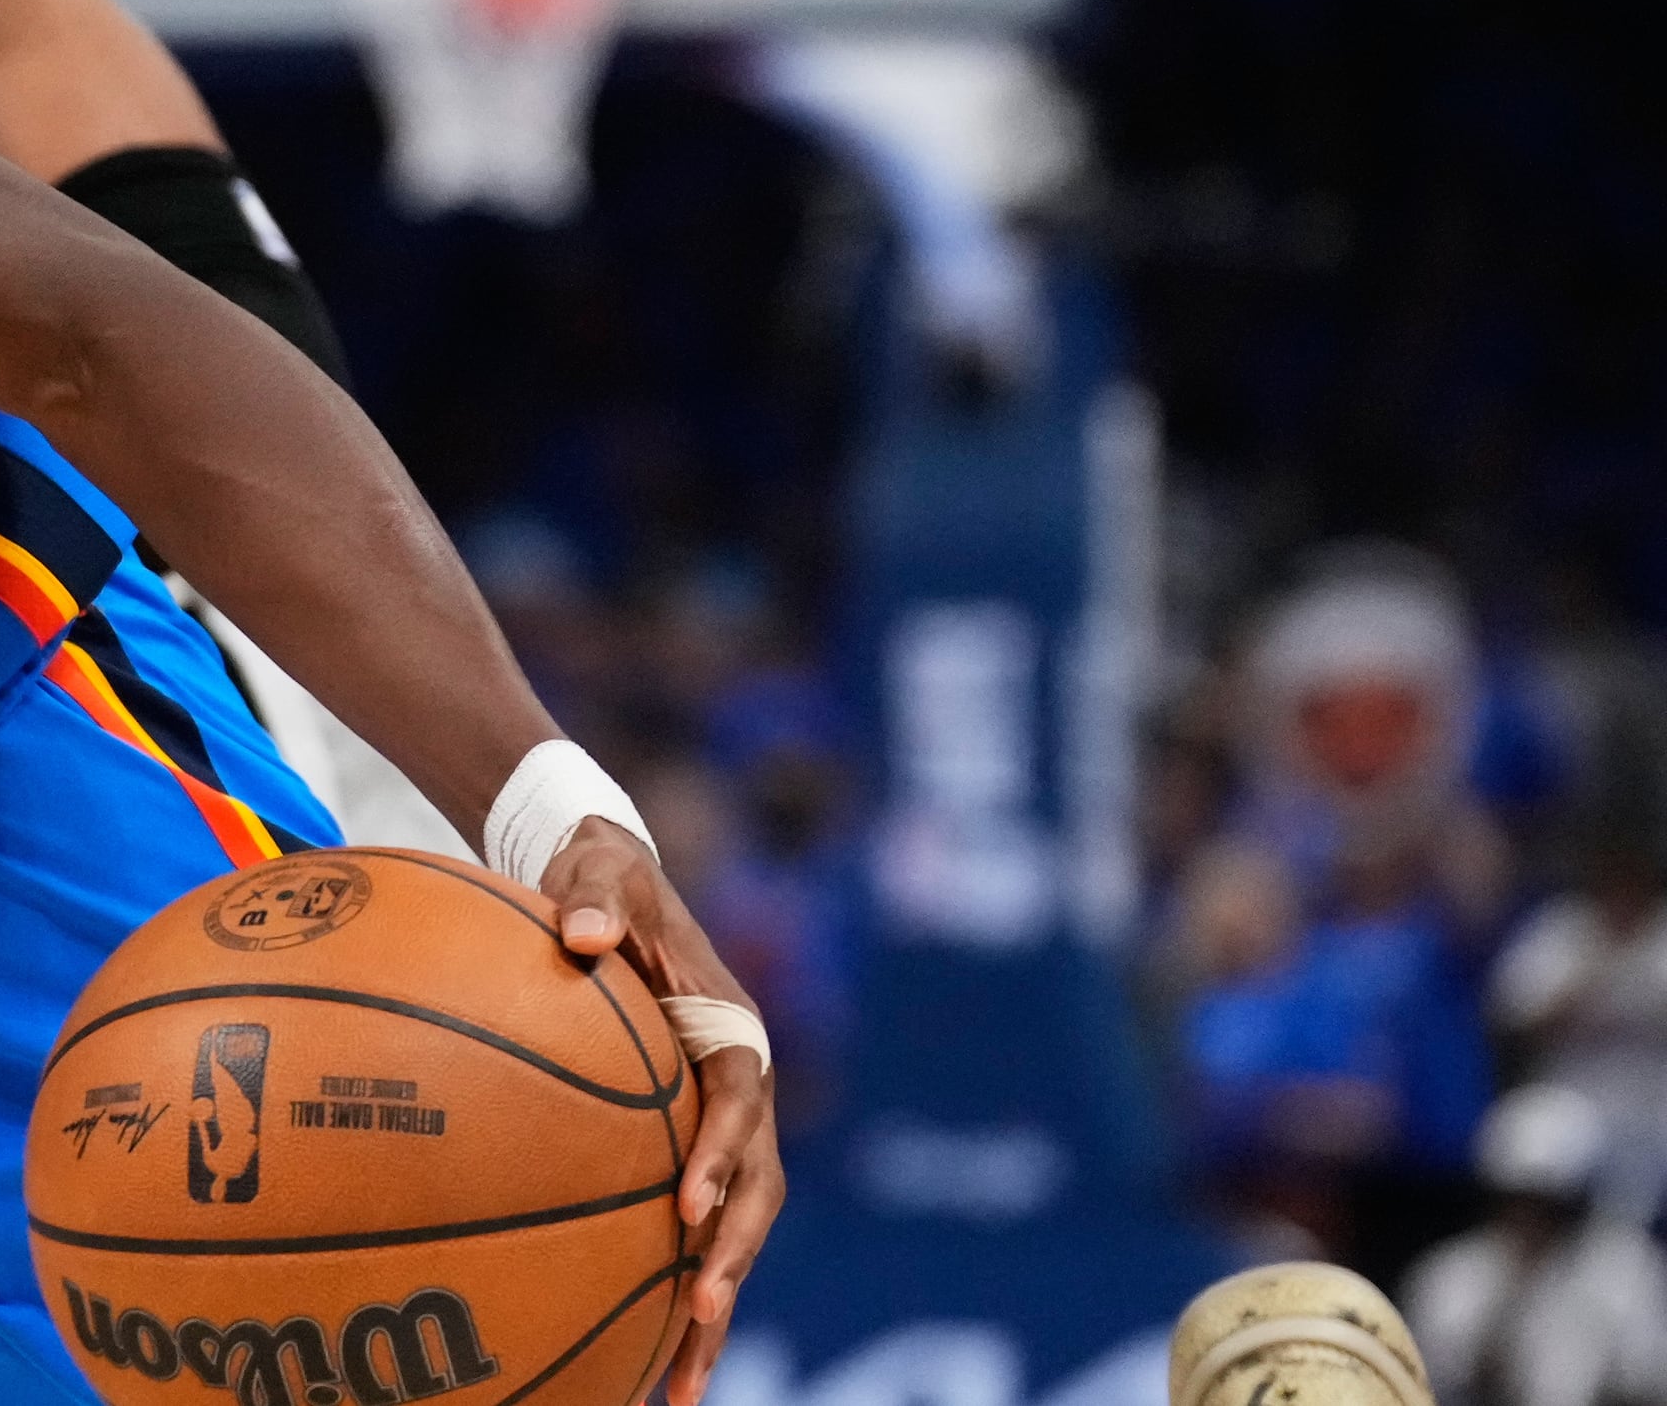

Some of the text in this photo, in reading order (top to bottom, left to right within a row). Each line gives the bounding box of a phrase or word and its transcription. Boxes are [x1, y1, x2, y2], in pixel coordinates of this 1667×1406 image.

[290, 1100, 325, 1128] BALL
[330, 1101, 373, 1129] GAME
[61, 1278, 500, 1406] Wilson
